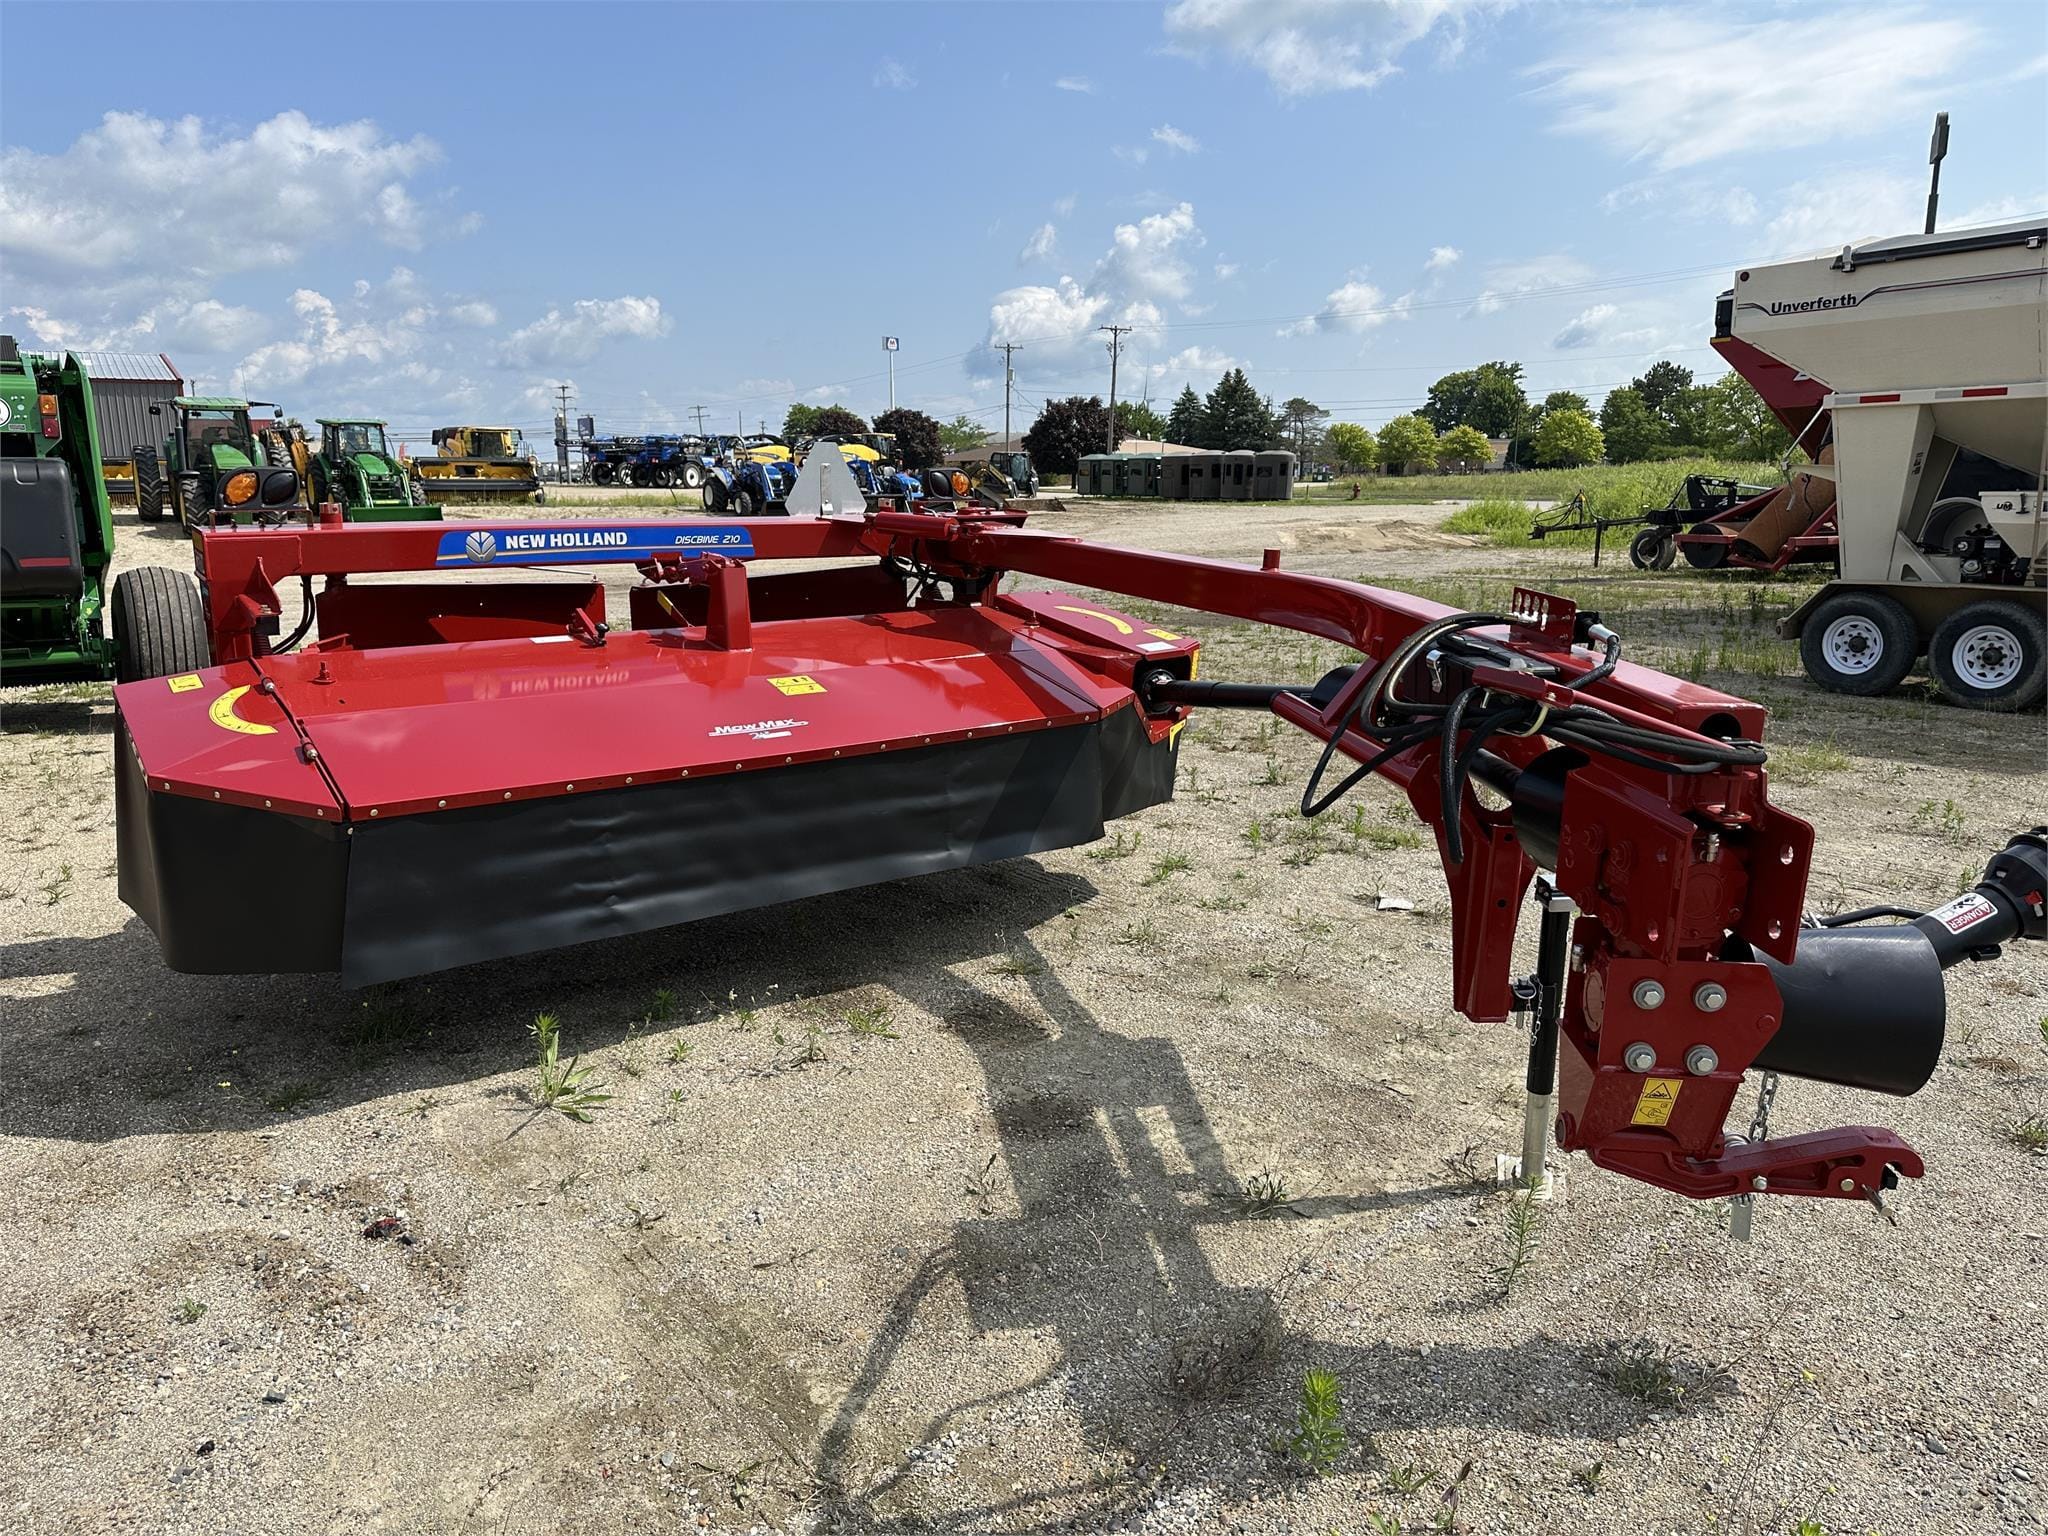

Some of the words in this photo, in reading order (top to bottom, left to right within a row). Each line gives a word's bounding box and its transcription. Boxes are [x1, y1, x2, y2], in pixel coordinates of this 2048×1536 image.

[1771, 294, 1857, 314] Unverferth
[1996, 501, 2013, 511] UM
[505, 534, 546, 550] NEW
[550, 532, 627, 547] HOLLAND
[675, 535, 719, 545] DISCBINE
[723, 534, 740, 544] 210
[1948, 907, 1983, 929] DANGER
